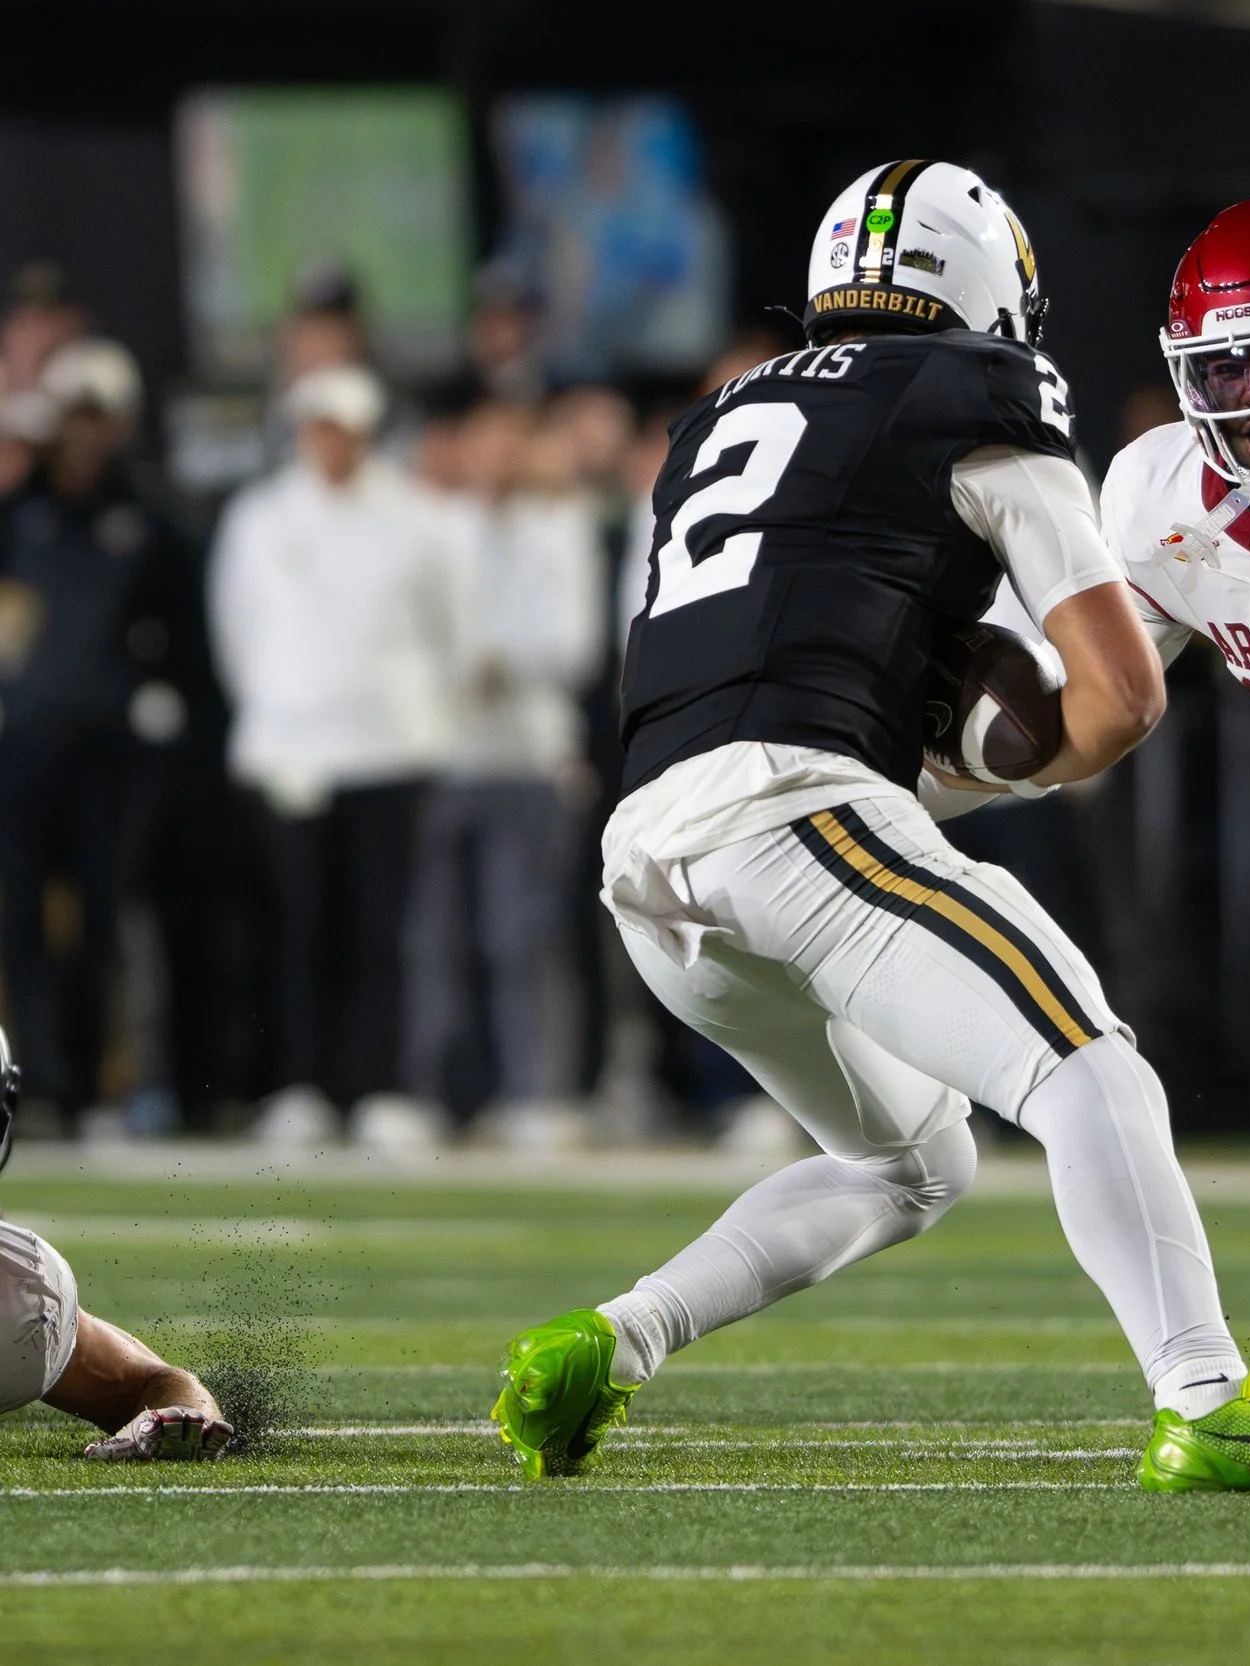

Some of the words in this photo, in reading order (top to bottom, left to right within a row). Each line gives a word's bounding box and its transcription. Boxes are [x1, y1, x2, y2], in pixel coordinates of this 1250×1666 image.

[869, 215, 892, 225] C2P
[882, 248, 895, 265] 2
[813, 290, 943, 321] VANDERBILT
[1034, 354, 1070, 438] 2
[649, 402, 809, 619] 2
